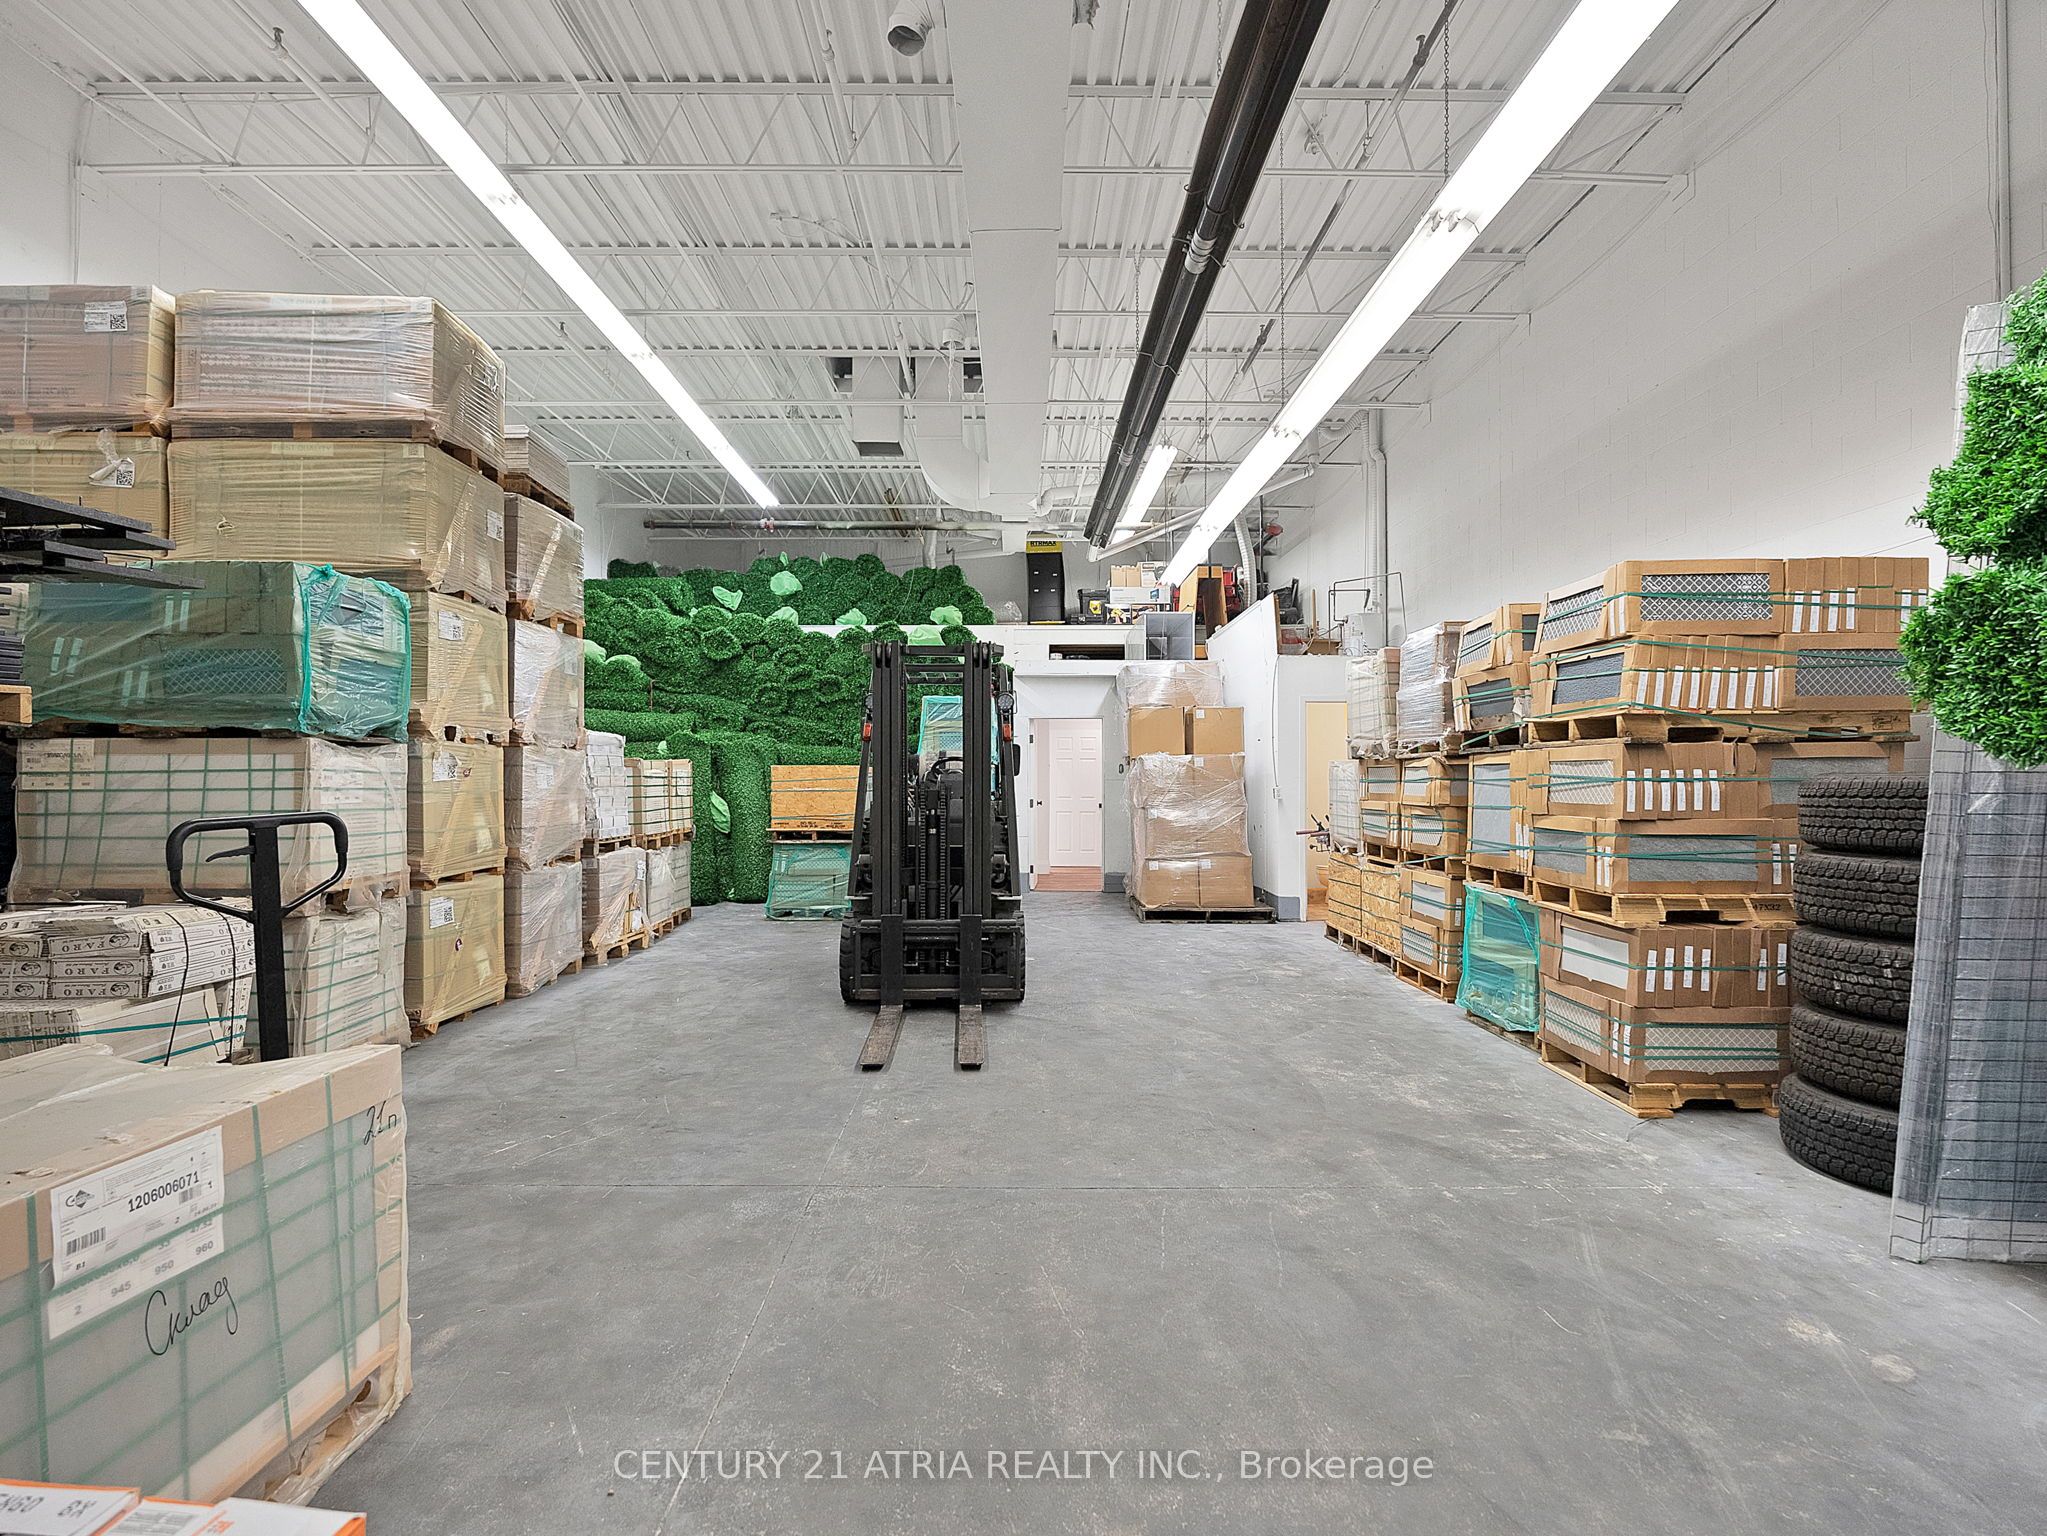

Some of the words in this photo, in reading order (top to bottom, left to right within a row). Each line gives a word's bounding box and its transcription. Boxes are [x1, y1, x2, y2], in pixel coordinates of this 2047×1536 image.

[64, 967, 110, 975] FARO
[63, 988, 107, 996] FARO
[127, 1170, 200, 1213] 1206006071
[195, 1240, 214, 1256] 960
[154, 1259, 175, 1275] 950
[110, 1280, 132, 1297] 945
